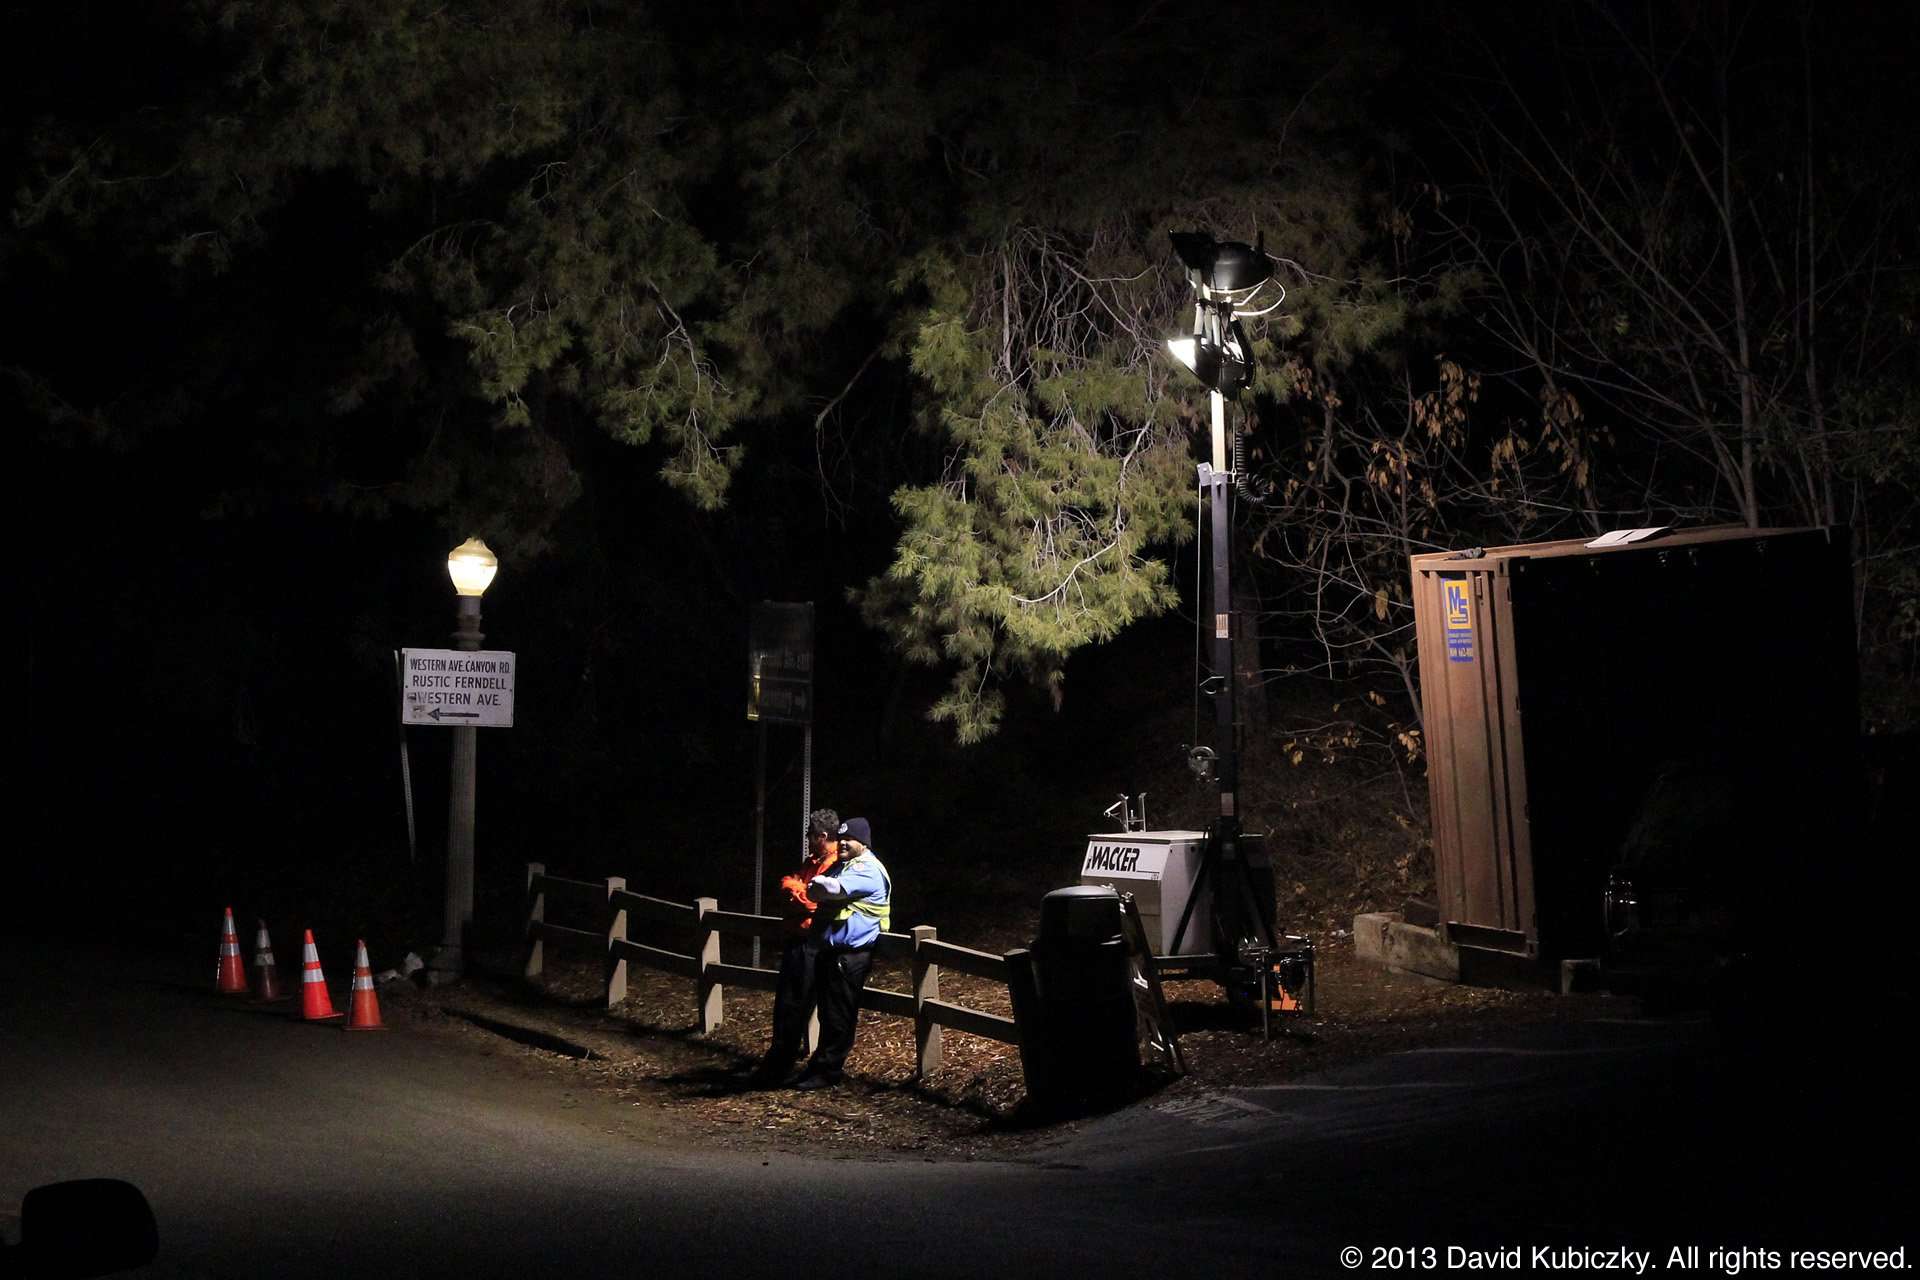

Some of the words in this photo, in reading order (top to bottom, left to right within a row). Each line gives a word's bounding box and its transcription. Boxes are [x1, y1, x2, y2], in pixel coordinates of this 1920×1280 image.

[410, 659, 446, 672] WESTERN
[466, 660, 496, 673] CANYON
[412, 675, 450, 688] RUSTIC
[455, 676, 507, 690] FERNDELL
[416, 691, 471, 705] WESTERN
[1091, 846, 1140, 872] WACKER
